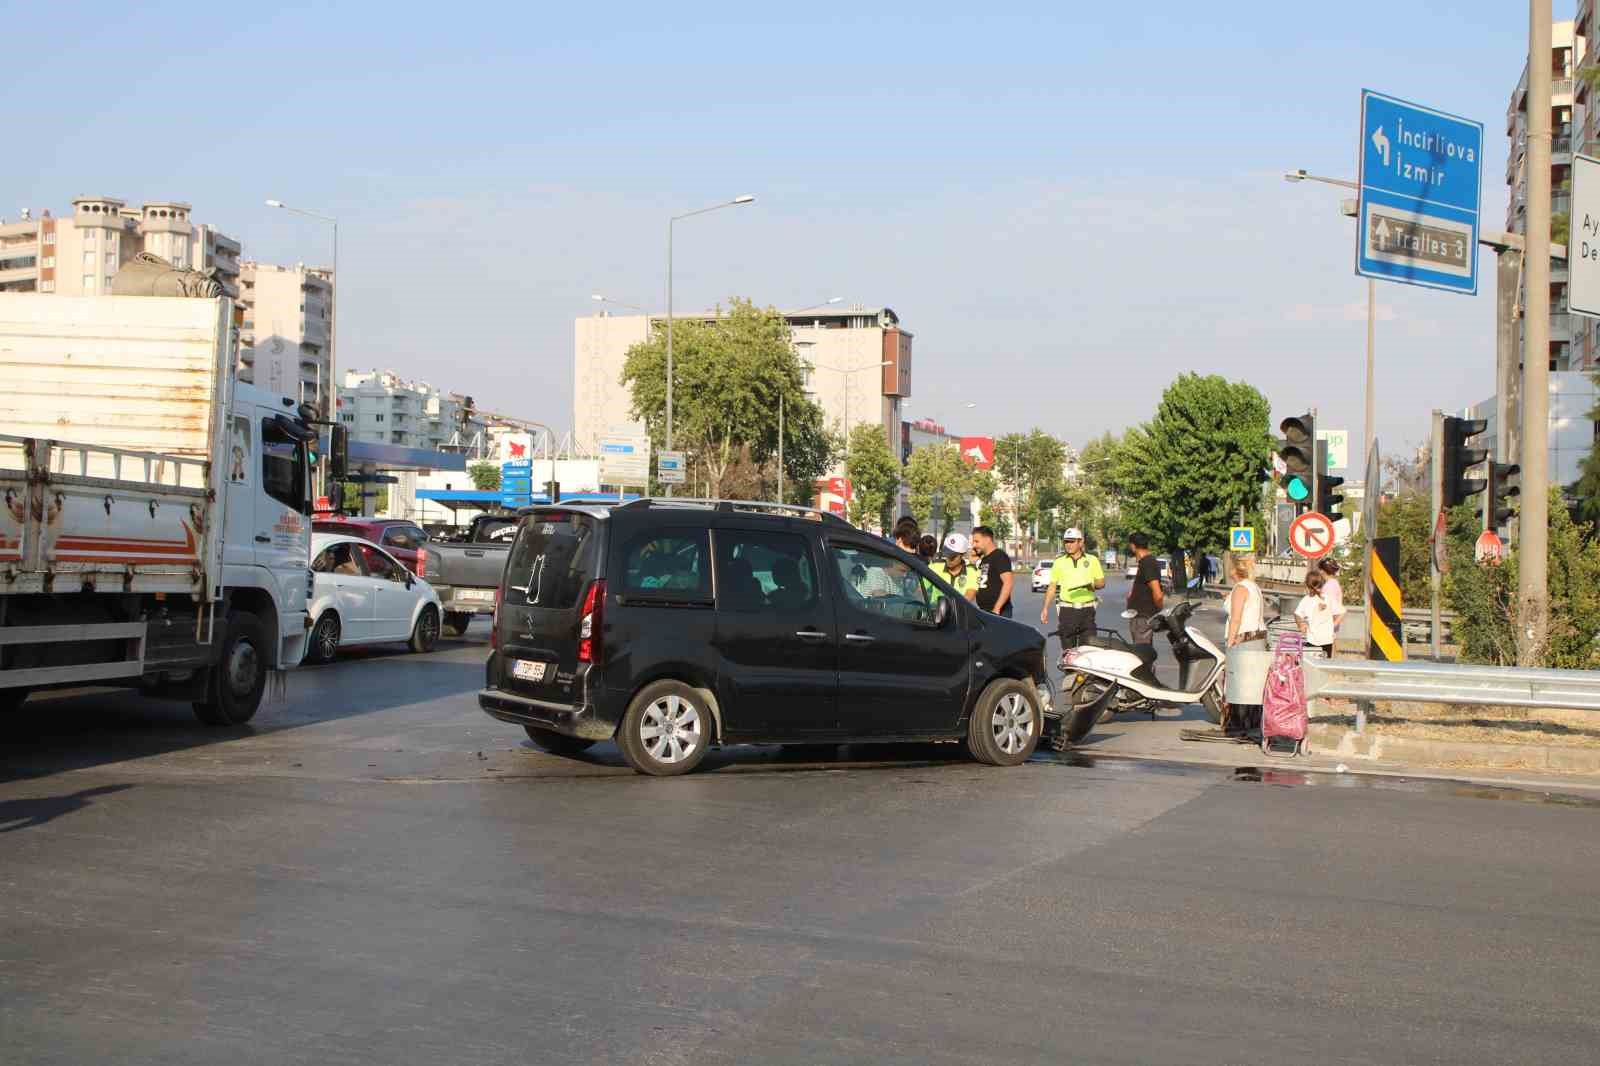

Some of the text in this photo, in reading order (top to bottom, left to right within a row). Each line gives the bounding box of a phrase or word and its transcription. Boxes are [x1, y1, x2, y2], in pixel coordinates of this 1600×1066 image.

[1398, 117, 1475, 163] İncirliova
[1397, 151, 1446, 187] İzmir
[1395, 226, 1464, 259] Tralles 3
[1582, 241, 1600, 261] De
